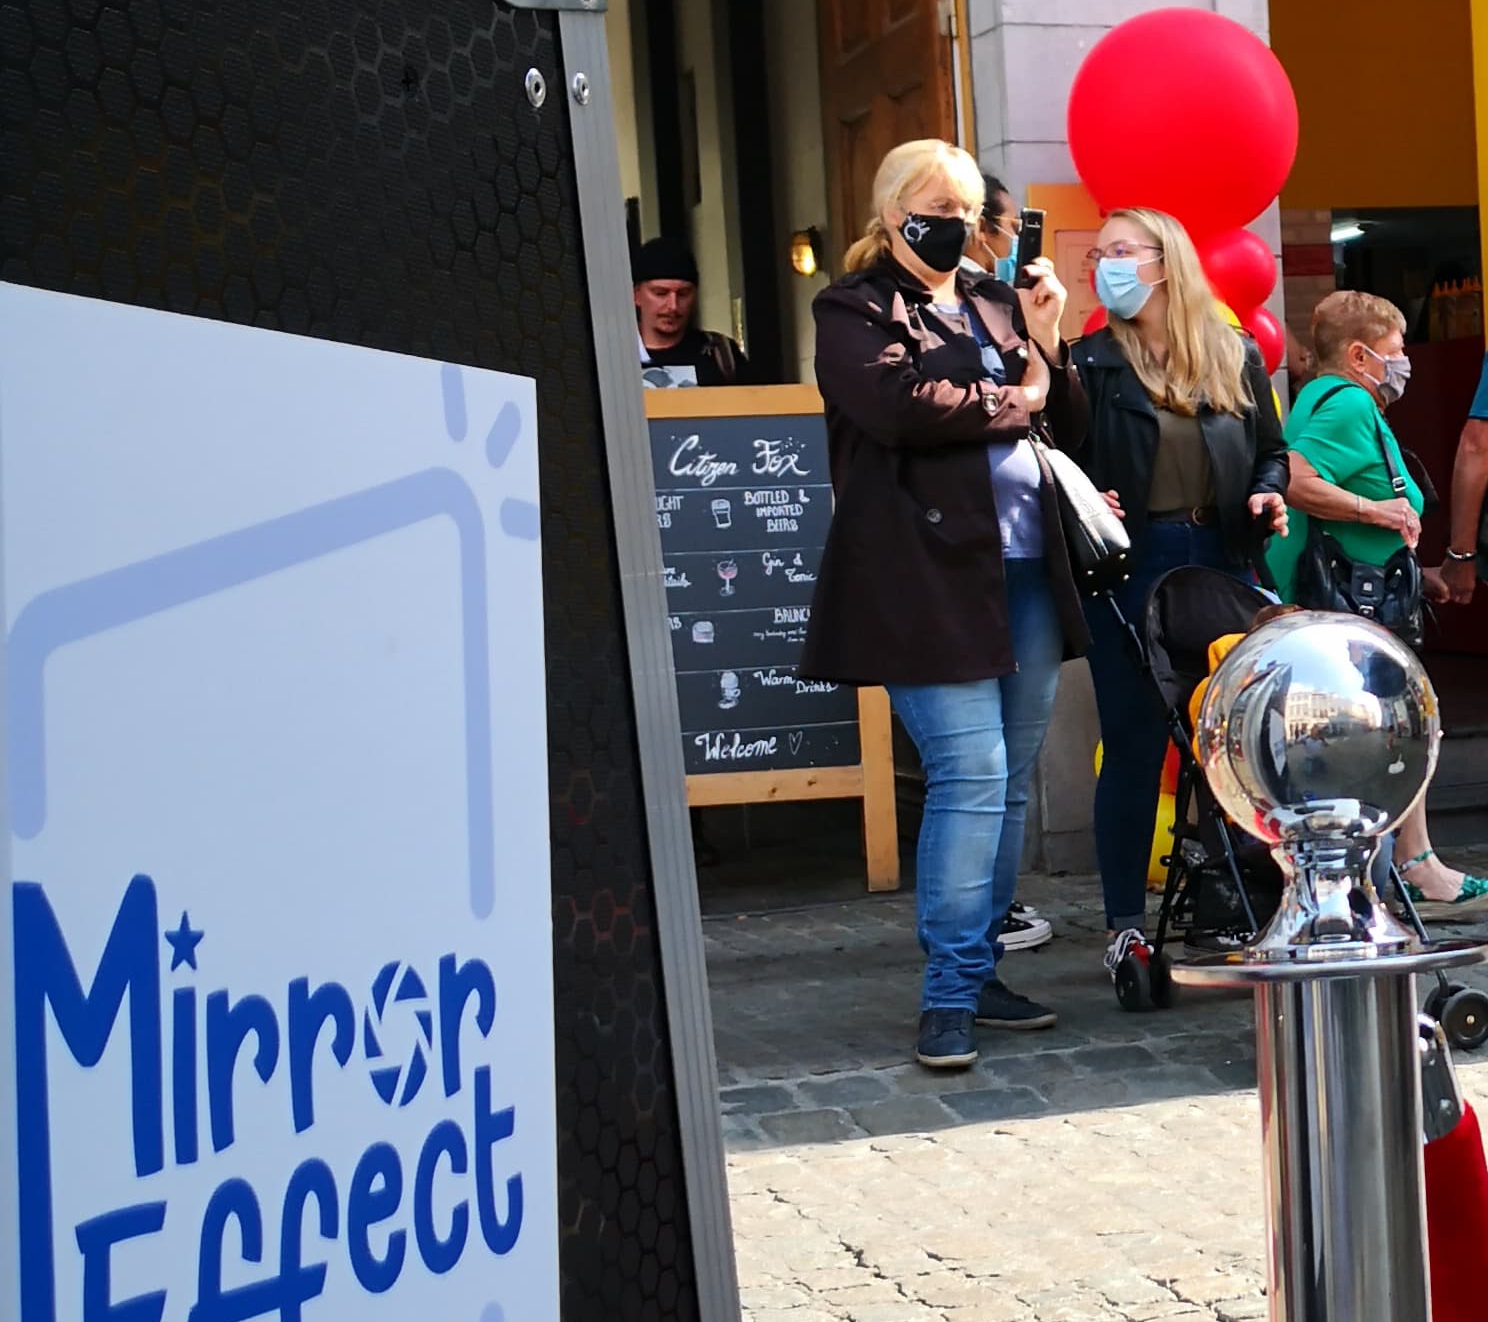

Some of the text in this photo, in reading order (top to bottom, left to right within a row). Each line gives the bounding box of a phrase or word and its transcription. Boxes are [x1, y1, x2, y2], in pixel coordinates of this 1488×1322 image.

[669, 434, 812, 487] Citizen Fox
[743, 490, 790, 506] BOTTLED
[756, 504, 804, 518] IMPORTED
[773, 608, 812, 625] BRUNC
[753, 668, 797, 687] Warm
[795, 679, 839, 694] Drinks
[695, 732, 778, 762] Welcome
